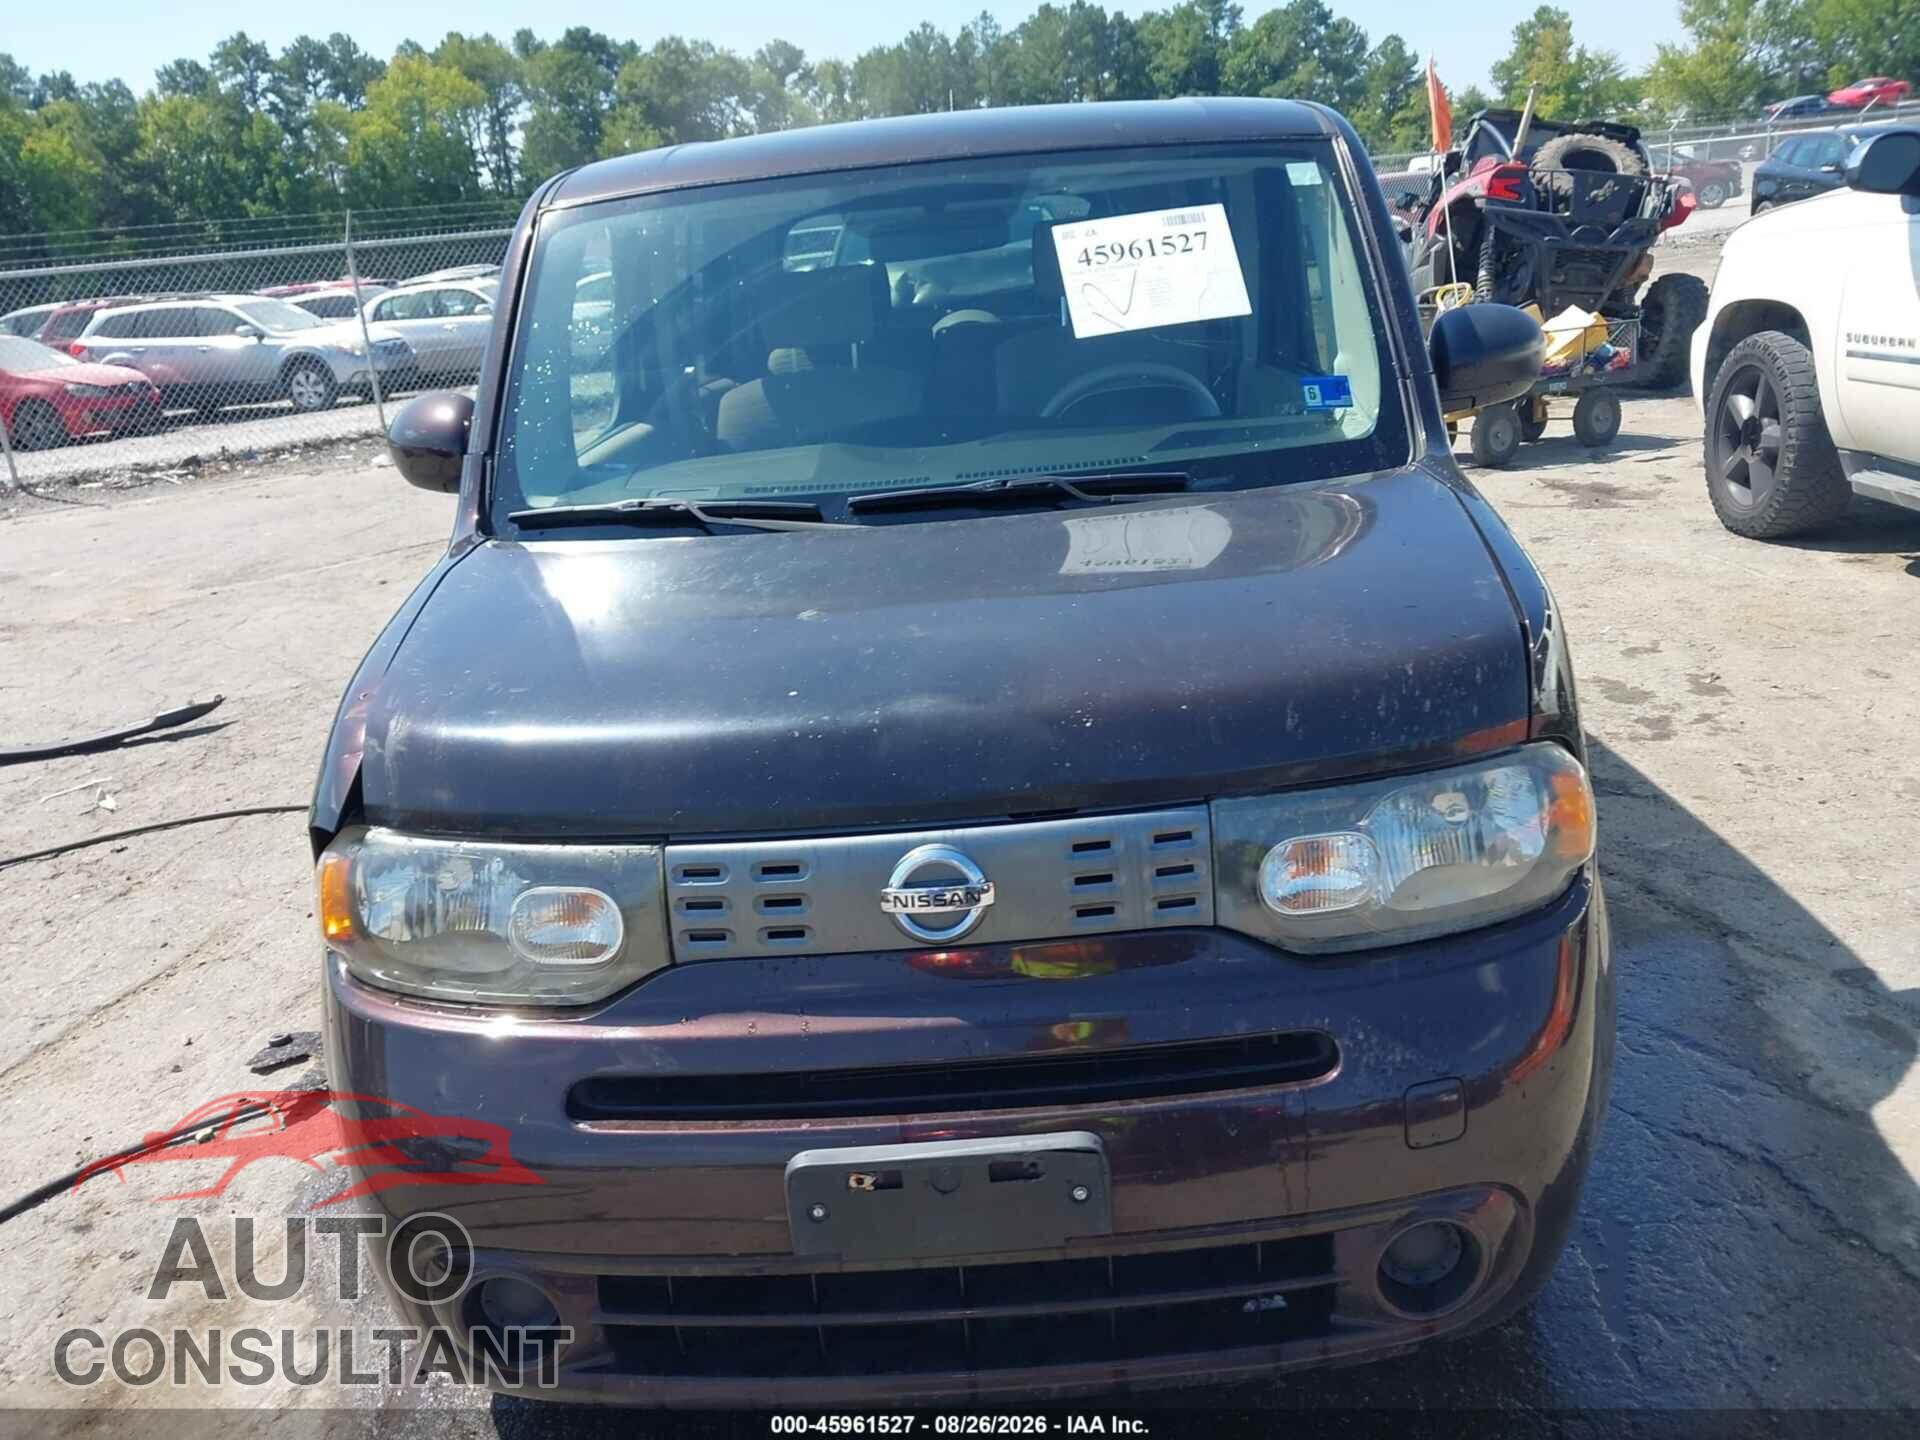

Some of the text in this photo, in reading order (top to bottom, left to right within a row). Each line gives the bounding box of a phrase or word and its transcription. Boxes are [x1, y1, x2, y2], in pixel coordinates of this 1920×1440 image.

[1077, 230, 1208, 266] 45961527
[1846, 332, 1916, 348] SUBURBAN
[893, 890, 982, 908] NISSAN
